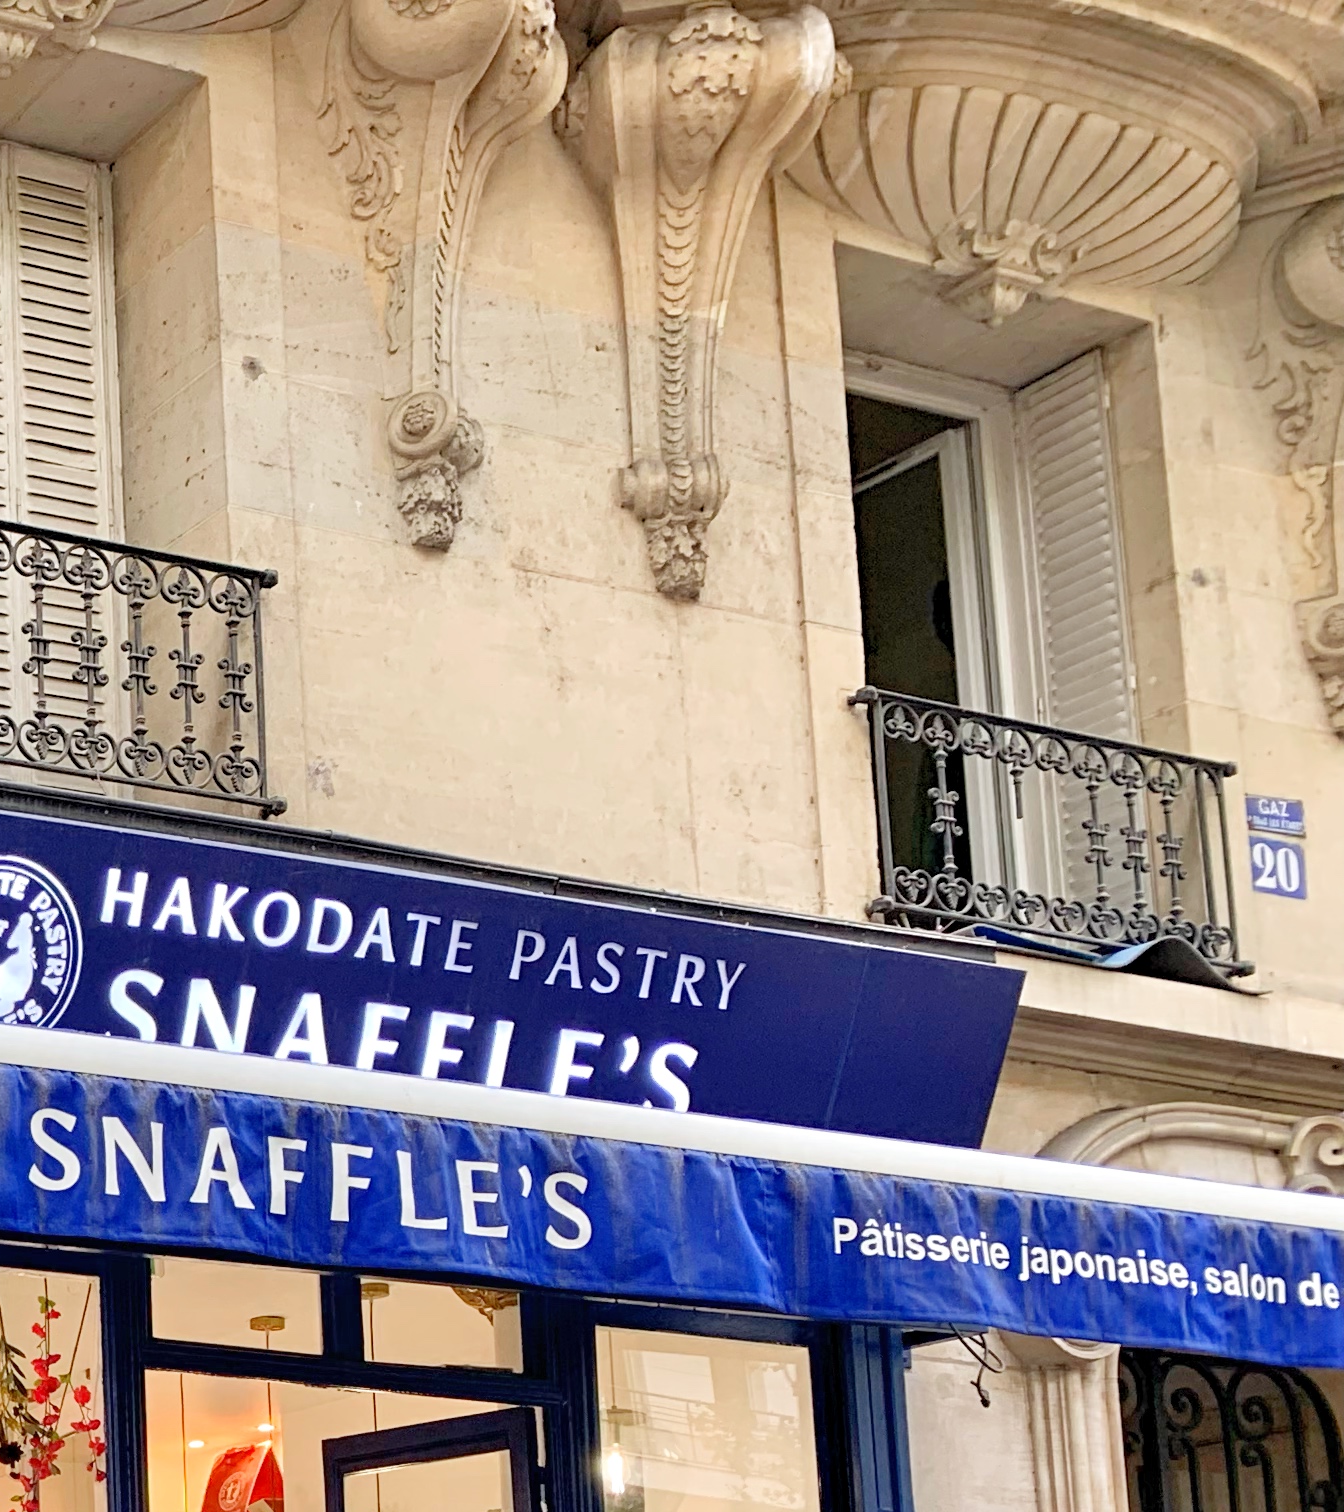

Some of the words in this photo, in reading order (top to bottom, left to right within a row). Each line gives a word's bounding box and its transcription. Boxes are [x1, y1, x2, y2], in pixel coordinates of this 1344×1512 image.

[1258, 798, 1290, 817] GAZ
[1253, 842, 1300, 893] 20
[29, 890, 68, 996] PASTRY
[98, 867, 480, 974] HAKODATE
[509, 928, 748, 1011] PASTRY
[28, 1107, 593, 1250] SNAFFLE'S
[832, 1217, 1010, 1270] Pâtisserie
[1018, 1236, 1200, 1297] japonaise,
[1204, 1263, 1287, 1305] salon
[1298, 1271, 1341, 1310] de
